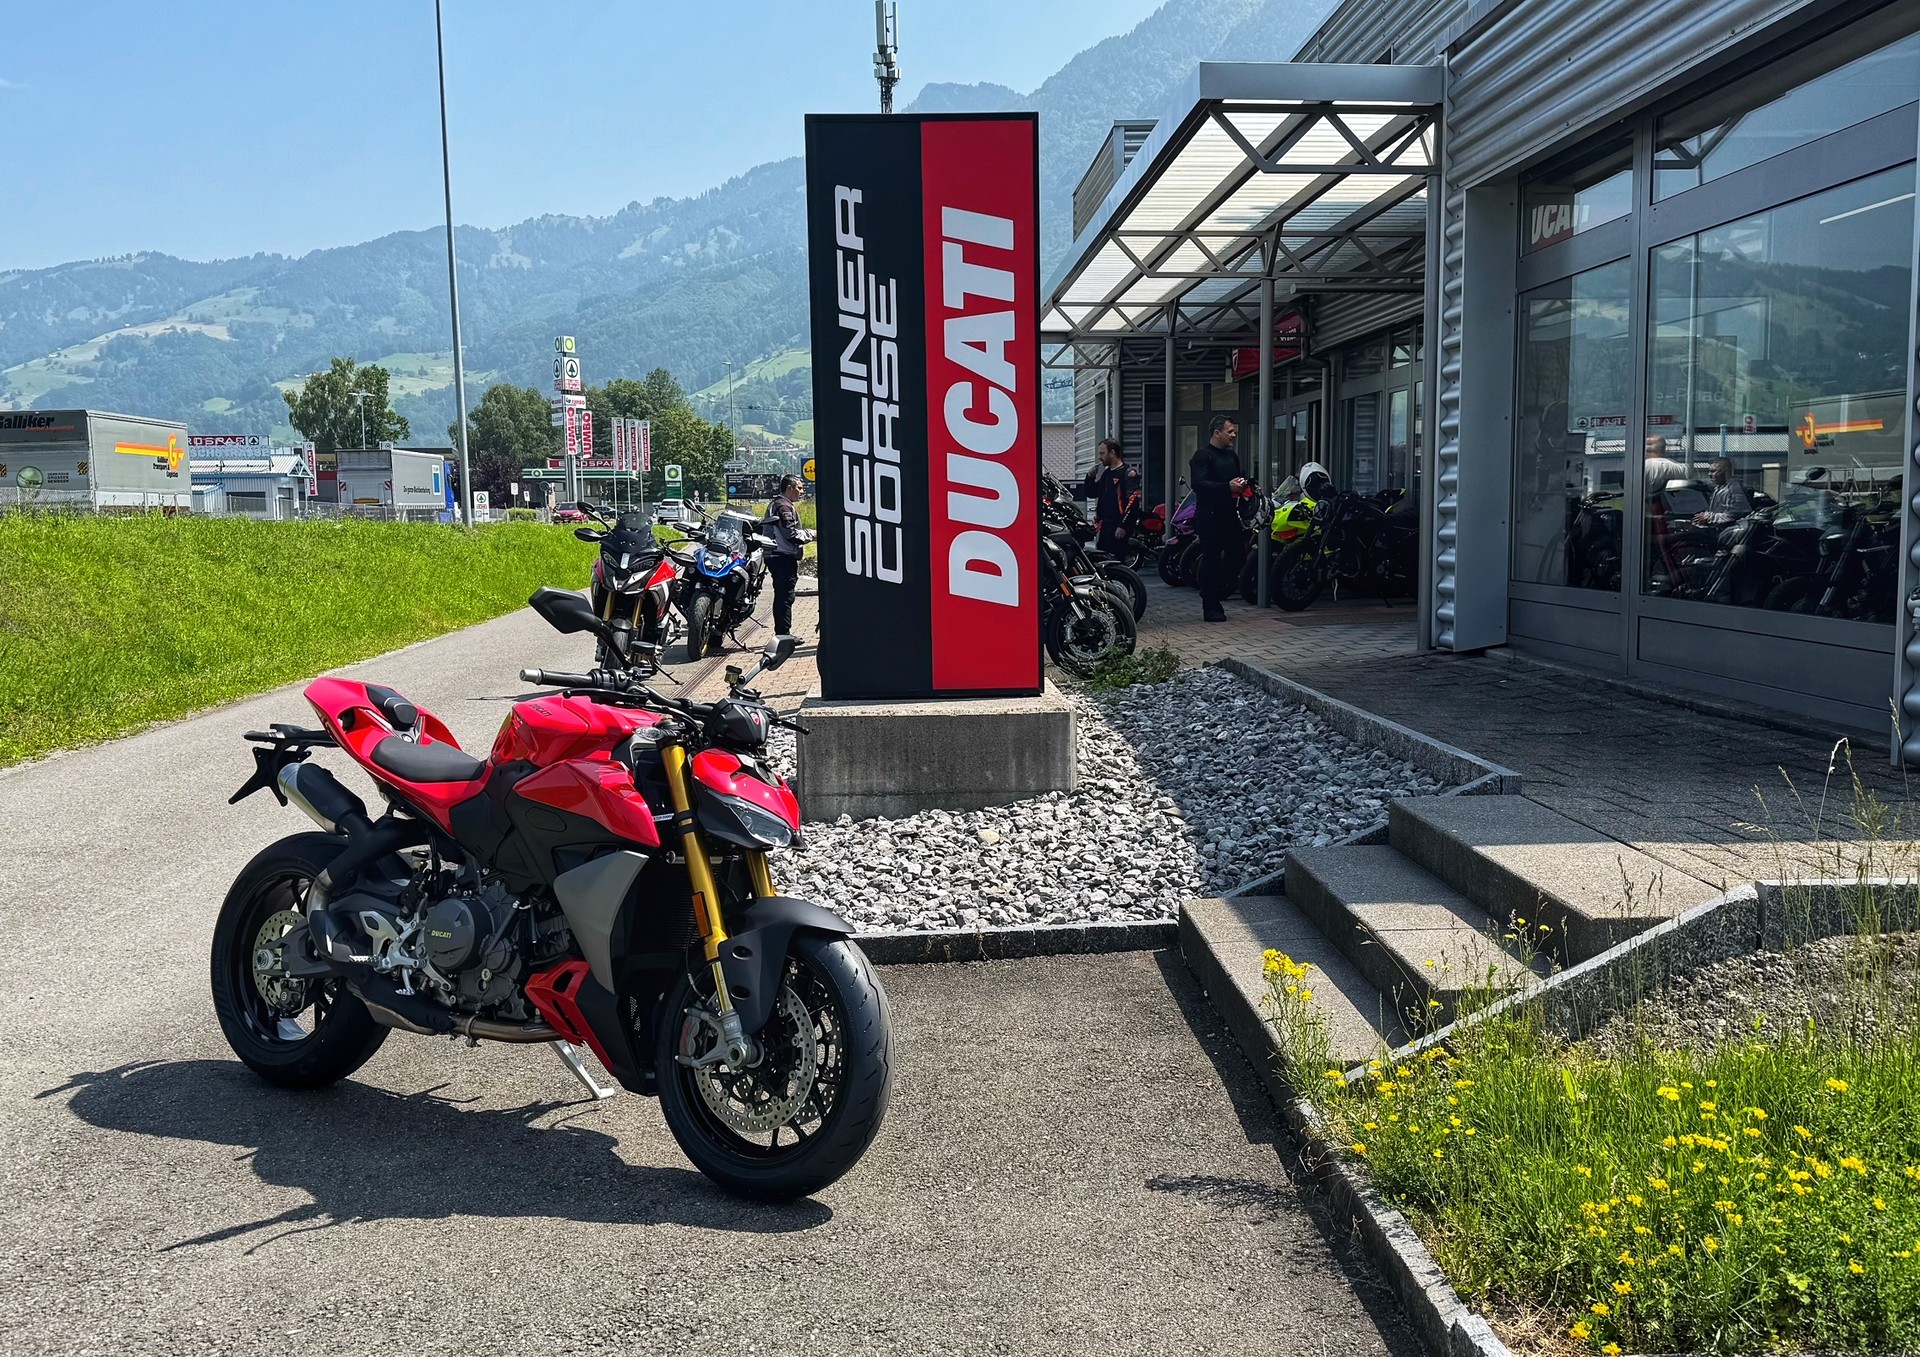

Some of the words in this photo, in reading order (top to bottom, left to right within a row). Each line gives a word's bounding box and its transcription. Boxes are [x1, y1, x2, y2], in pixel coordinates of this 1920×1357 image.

[834, 184, 873, 579] SELINER
[869, 273, 903, 585] CORSE
[940, 205, 1021, 608] DUCATI
[188, 437, 245, 446] ROSPAR
[582, 412, 592, 457] JUMBO
[529, 703, 552, 717] DUCATI
[431, 930, 452, 939] DUCATI
